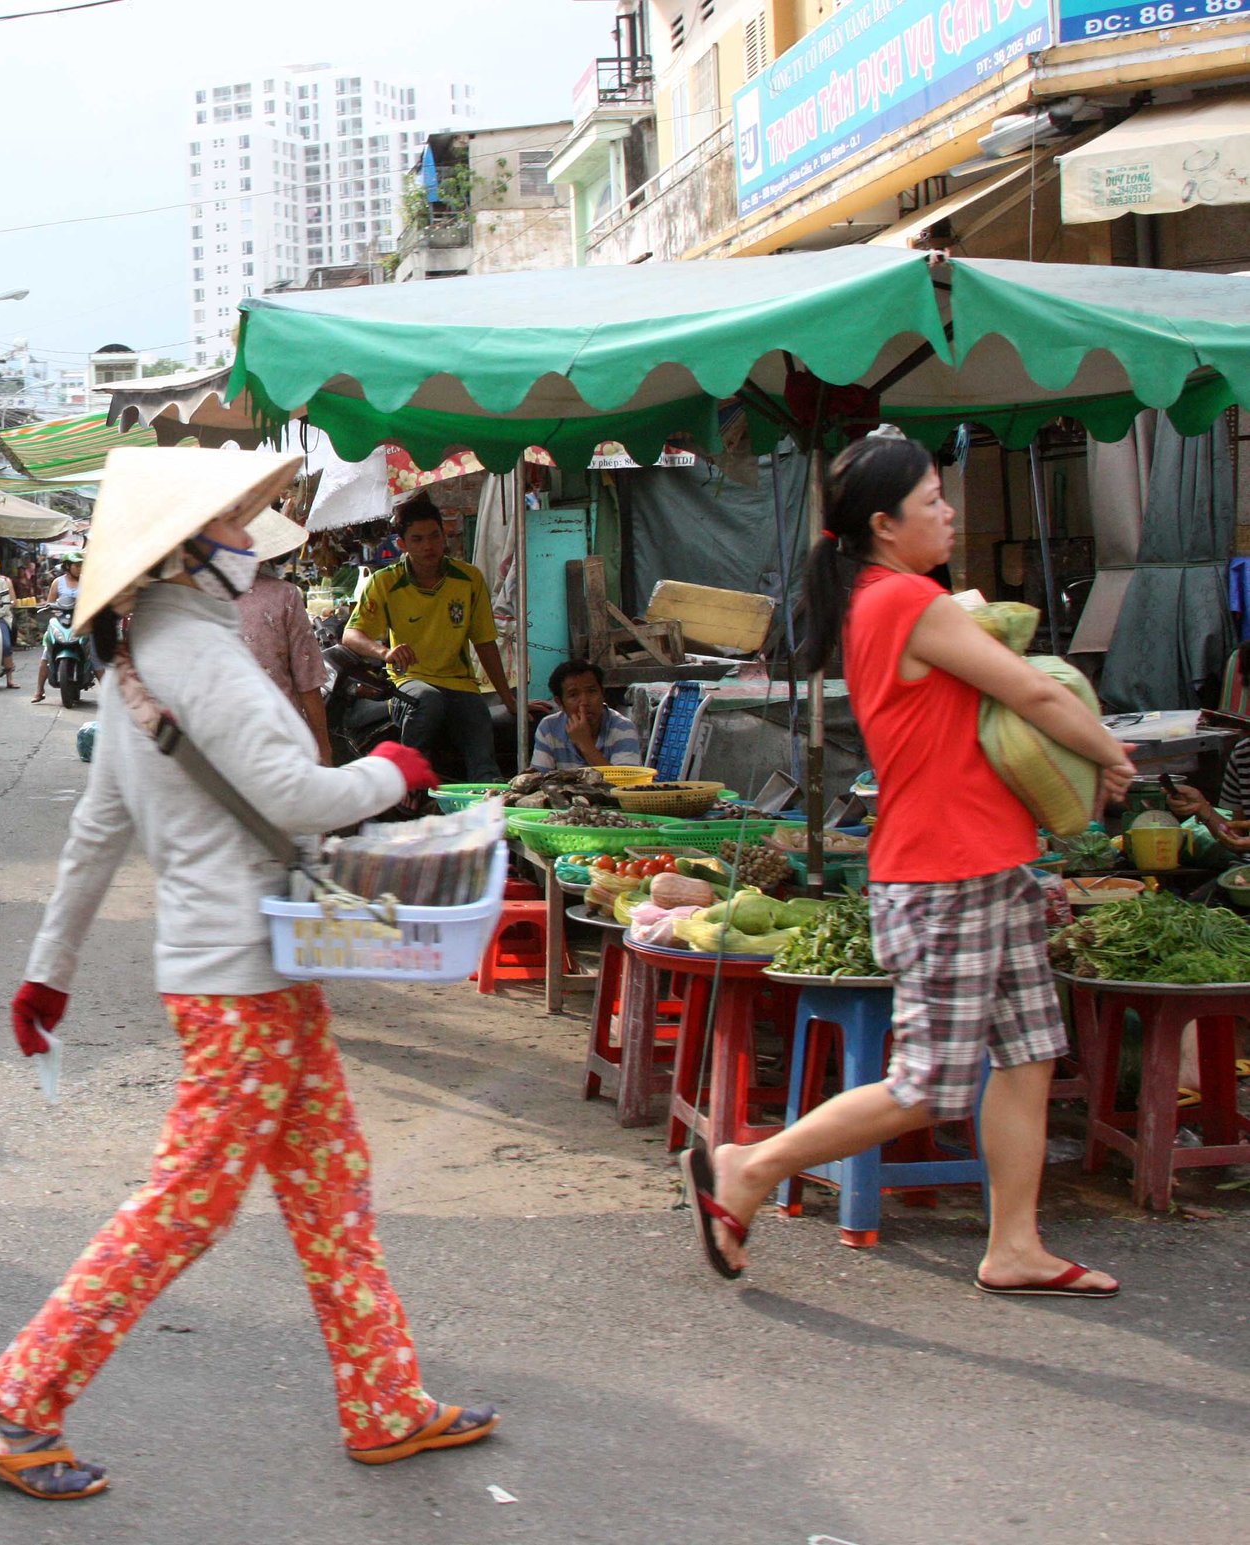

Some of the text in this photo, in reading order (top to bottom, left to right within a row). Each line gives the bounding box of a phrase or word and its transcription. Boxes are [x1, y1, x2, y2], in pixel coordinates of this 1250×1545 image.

[1084, 14, 1131, 34] ĐC:
[1139, 3, 1175, 25] 86
[1206, 0, 1242, 13] 88
[976, 27, 1042, 75] ĐT: 38 205 407
[766, 95, 818, 167] TRUNG
[818, 68, 855, 134] TÂM
[857, 35, 902, 113] DỊCH
[903, 12, 936, 81] VỤ
